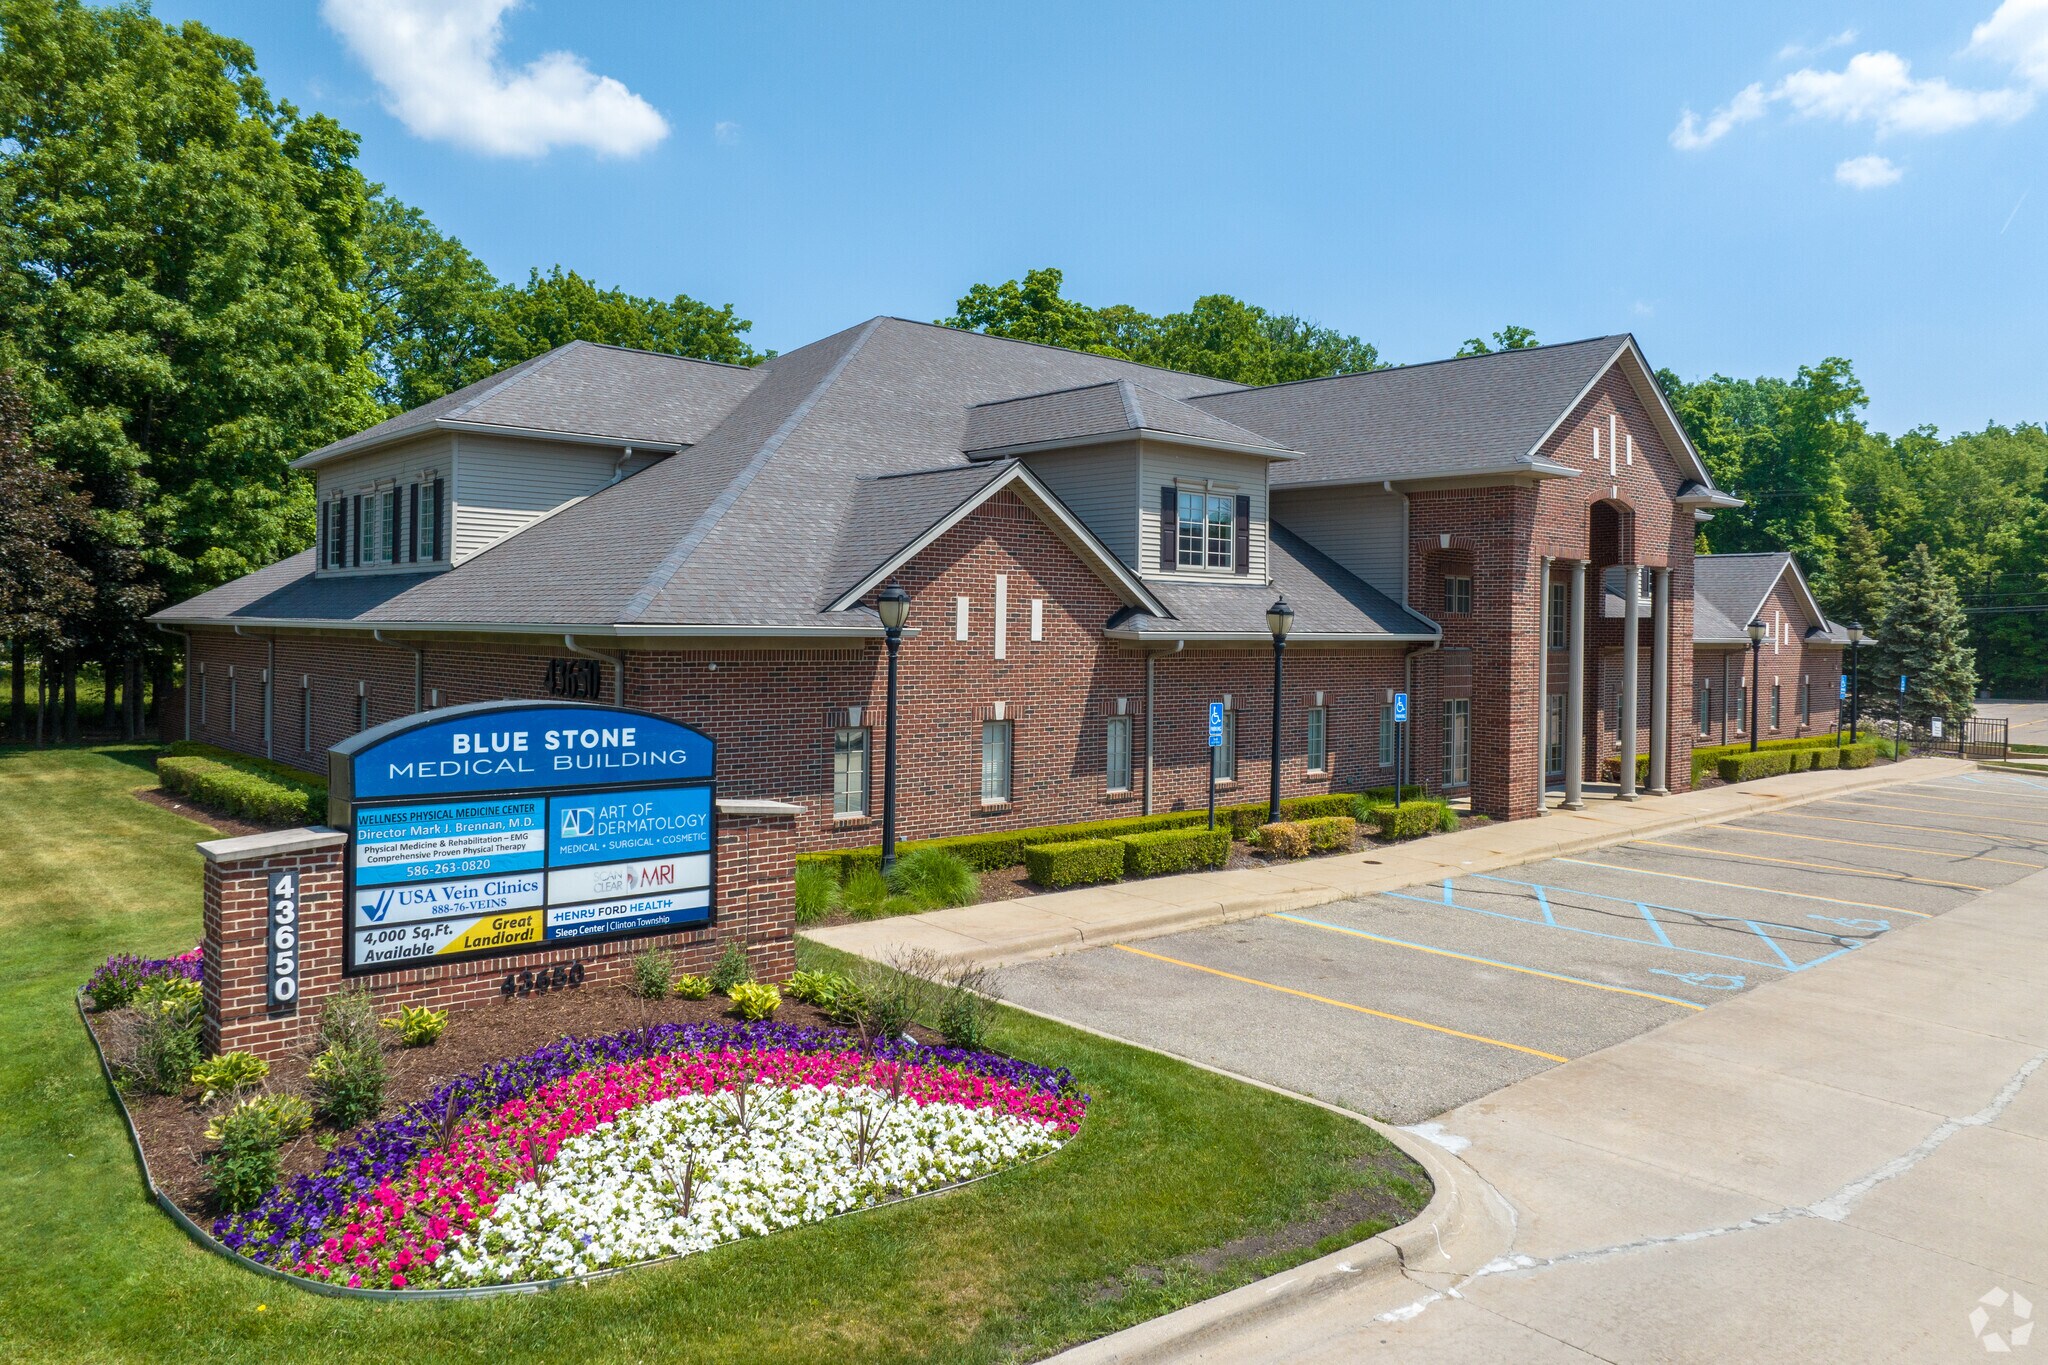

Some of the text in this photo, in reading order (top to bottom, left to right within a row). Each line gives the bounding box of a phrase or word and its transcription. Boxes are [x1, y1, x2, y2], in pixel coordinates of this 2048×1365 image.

[453, 727, 636, 754] BLUE STONE
[389, 750, 687, 779] MEDICAL BUILDING
[358, 803, 535, 825] WELLNESS PHYSICAL MEDICINE CENTER
[599, 802, 653, 820] ART OF
[358, 818, 535, 840] Director Mark J. Brennan, M.D.
[598, 813, 707, 836] DERMATOLOGY
[364, 844, 398, 854] Physical
[400, 840, 438, 851] Medicine
[439, 840, 446, 848] &
[448, 835, 502, 847] Rehabilitation
[511, 833, 528, 842] EMG
[367, 842, 526, 864] Comprehensive Proven Physical Therapy
[560, 832, 707, 854] MEDICAL SURGICAL COSMETIC
[406, 859, 490, 877] 586-263-0820
[640, 864, 674, 888] MRI
[399, 880, 538, 905] USA Vein Clinics
[594, 881, 622, 894] CLEAR
[432, 898, 507, 914] 888-76-VEINS
[554, 900, 673, 922] HENRY FORD HEALTH
[492, 916, 533, 930] Great
[555, 915, 670, 938] Sleep Center Clinton Township
[274, 875, 296, 1001] 43650
[364, 924, 453, 945] 4,000 Sq.Ft.
[464, 928, 534, 948] Landlord!
[364, 942, 435, 963] Available
[500, 963, 584, 994] 43650
